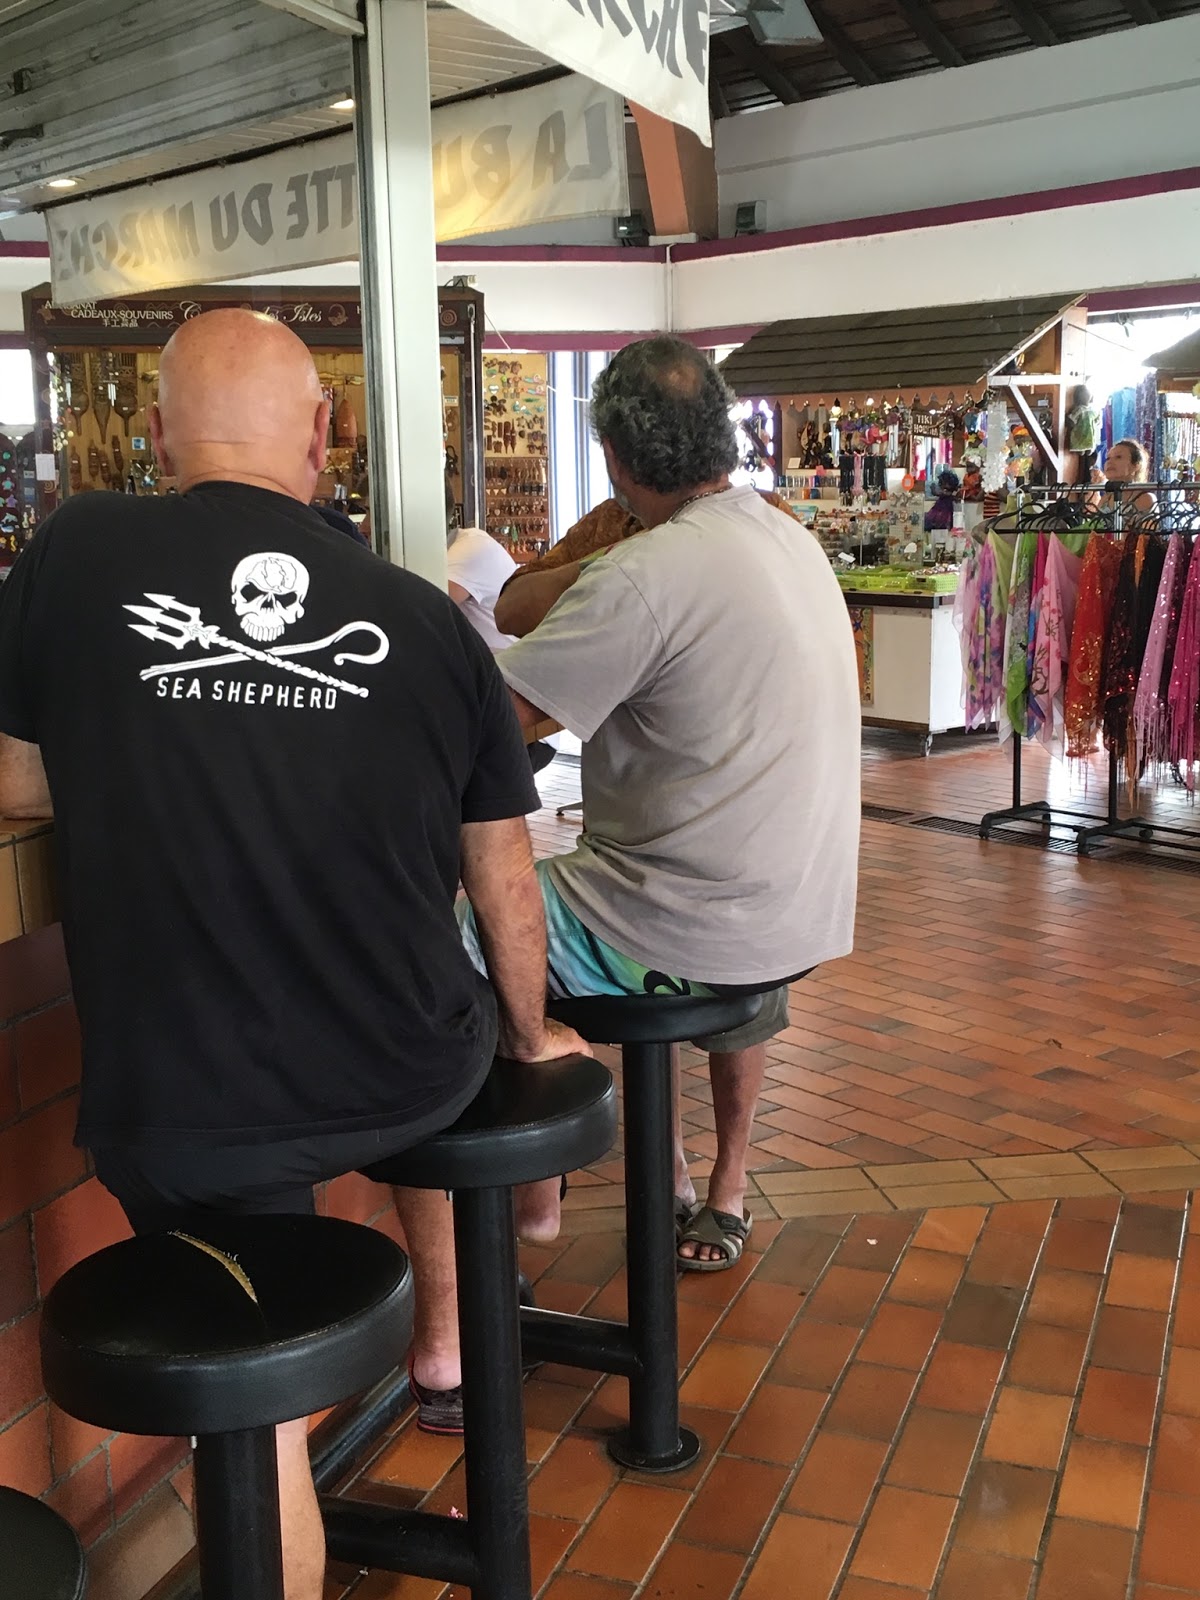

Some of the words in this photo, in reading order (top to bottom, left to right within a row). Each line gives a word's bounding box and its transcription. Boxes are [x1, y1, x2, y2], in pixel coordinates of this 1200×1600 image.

[70, 309, 174, 320] CADEAUX-SOUVENIRS
[915, 413, 933, 425] TIKI
[156, 676, 202, 700] SEA
[212, 679, 338, 710] SHEPHERD
